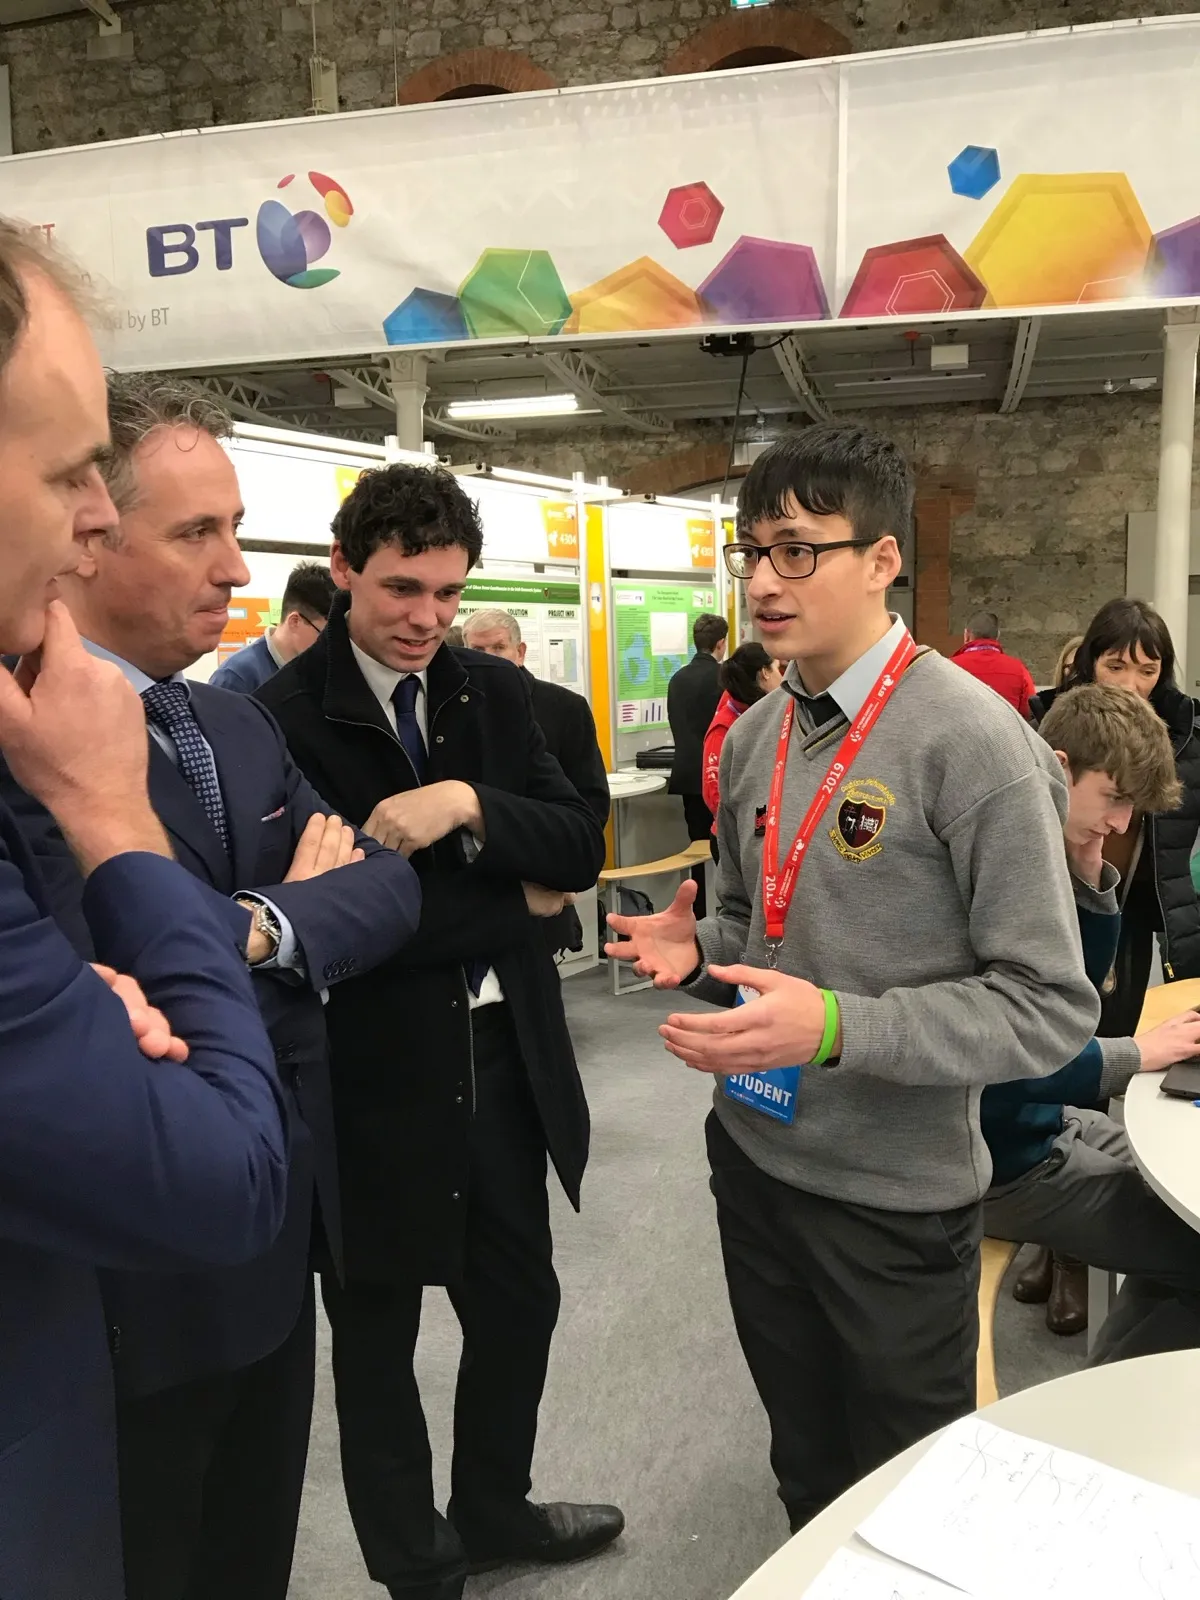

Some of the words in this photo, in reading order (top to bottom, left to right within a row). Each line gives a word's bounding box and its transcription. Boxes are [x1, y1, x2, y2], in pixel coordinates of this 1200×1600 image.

[146, 216, 249, 278] BT
[127, 309, 146, 332] by
[151, 307, 170, 326] BT
[877, 684, 887, 698] BT
[822, 762, 845, 795] 2019
[730, 1074, 792, 1107] STUDENT
